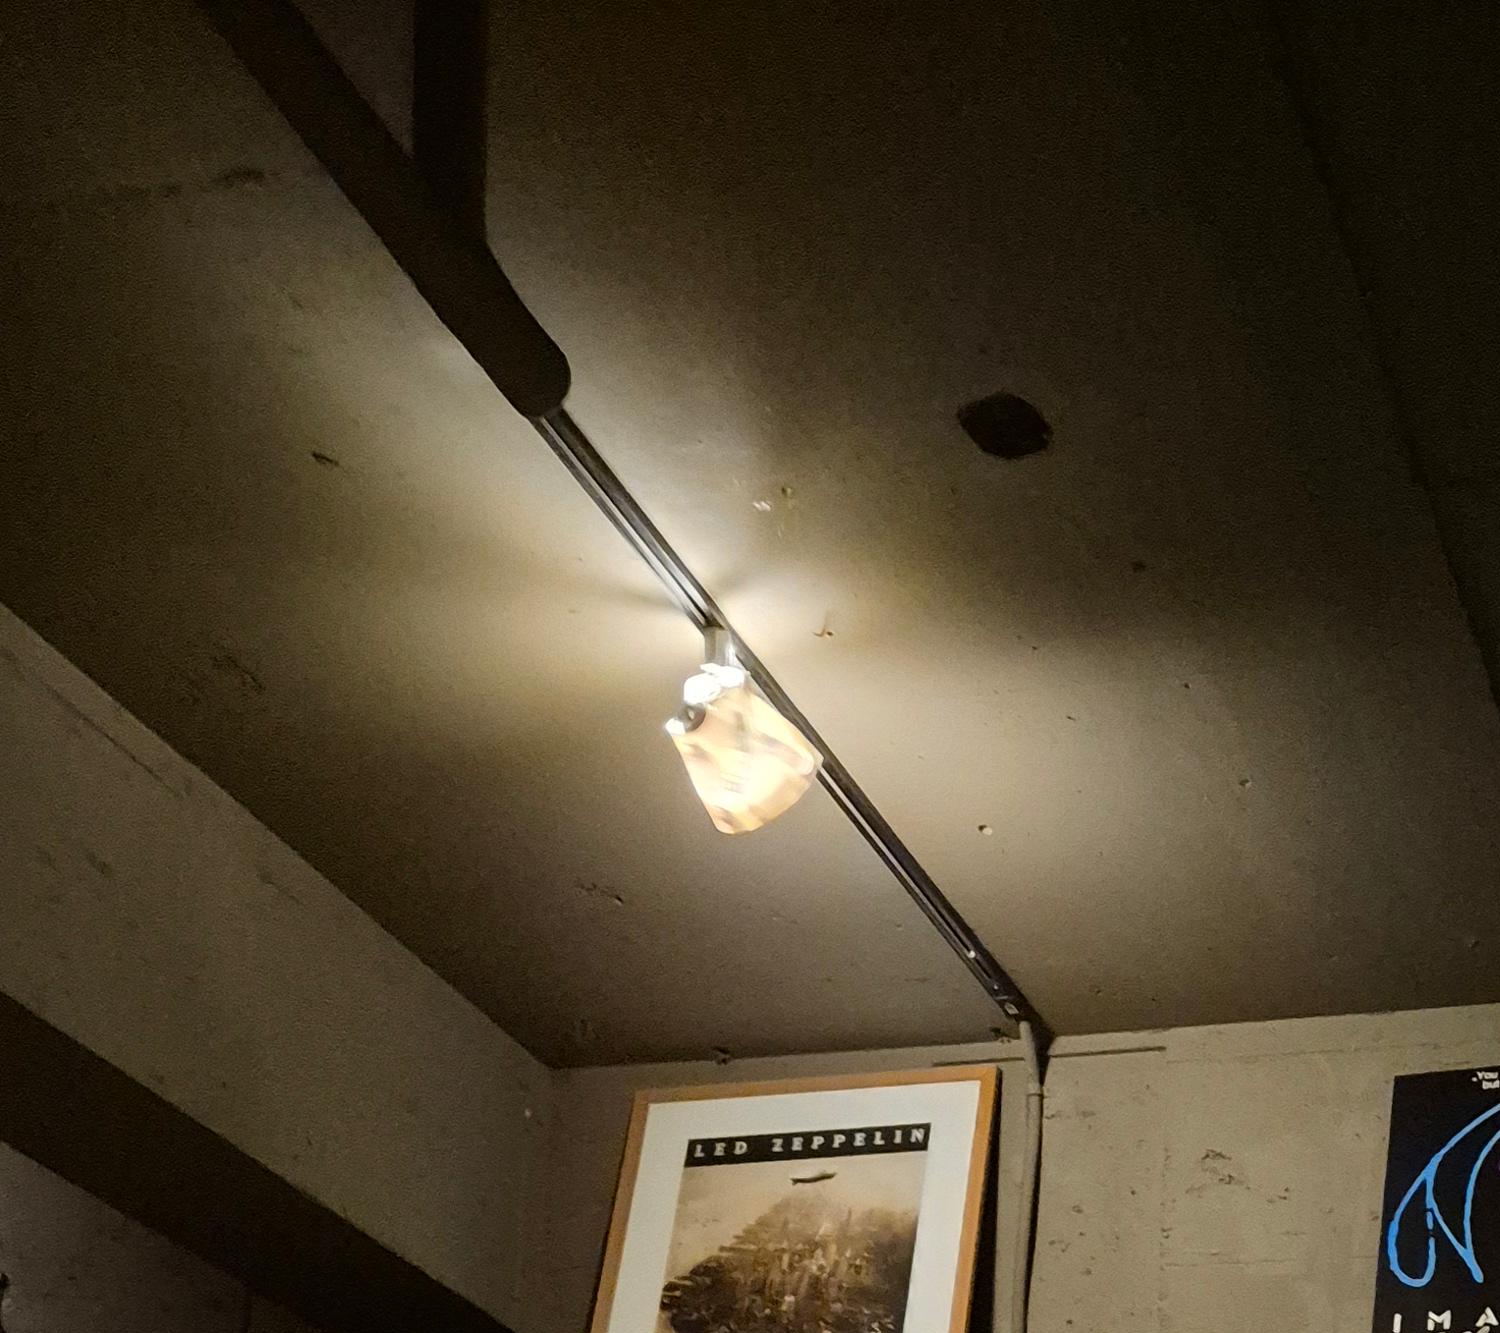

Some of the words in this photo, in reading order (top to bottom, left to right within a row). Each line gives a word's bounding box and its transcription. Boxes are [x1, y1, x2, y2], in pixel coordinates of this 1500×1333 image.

[1482, 1078, 1500, 1090] but
[693, 1140, 748, 1158] LED
[771, 1127, 926, 1153] ZEPPELIN
